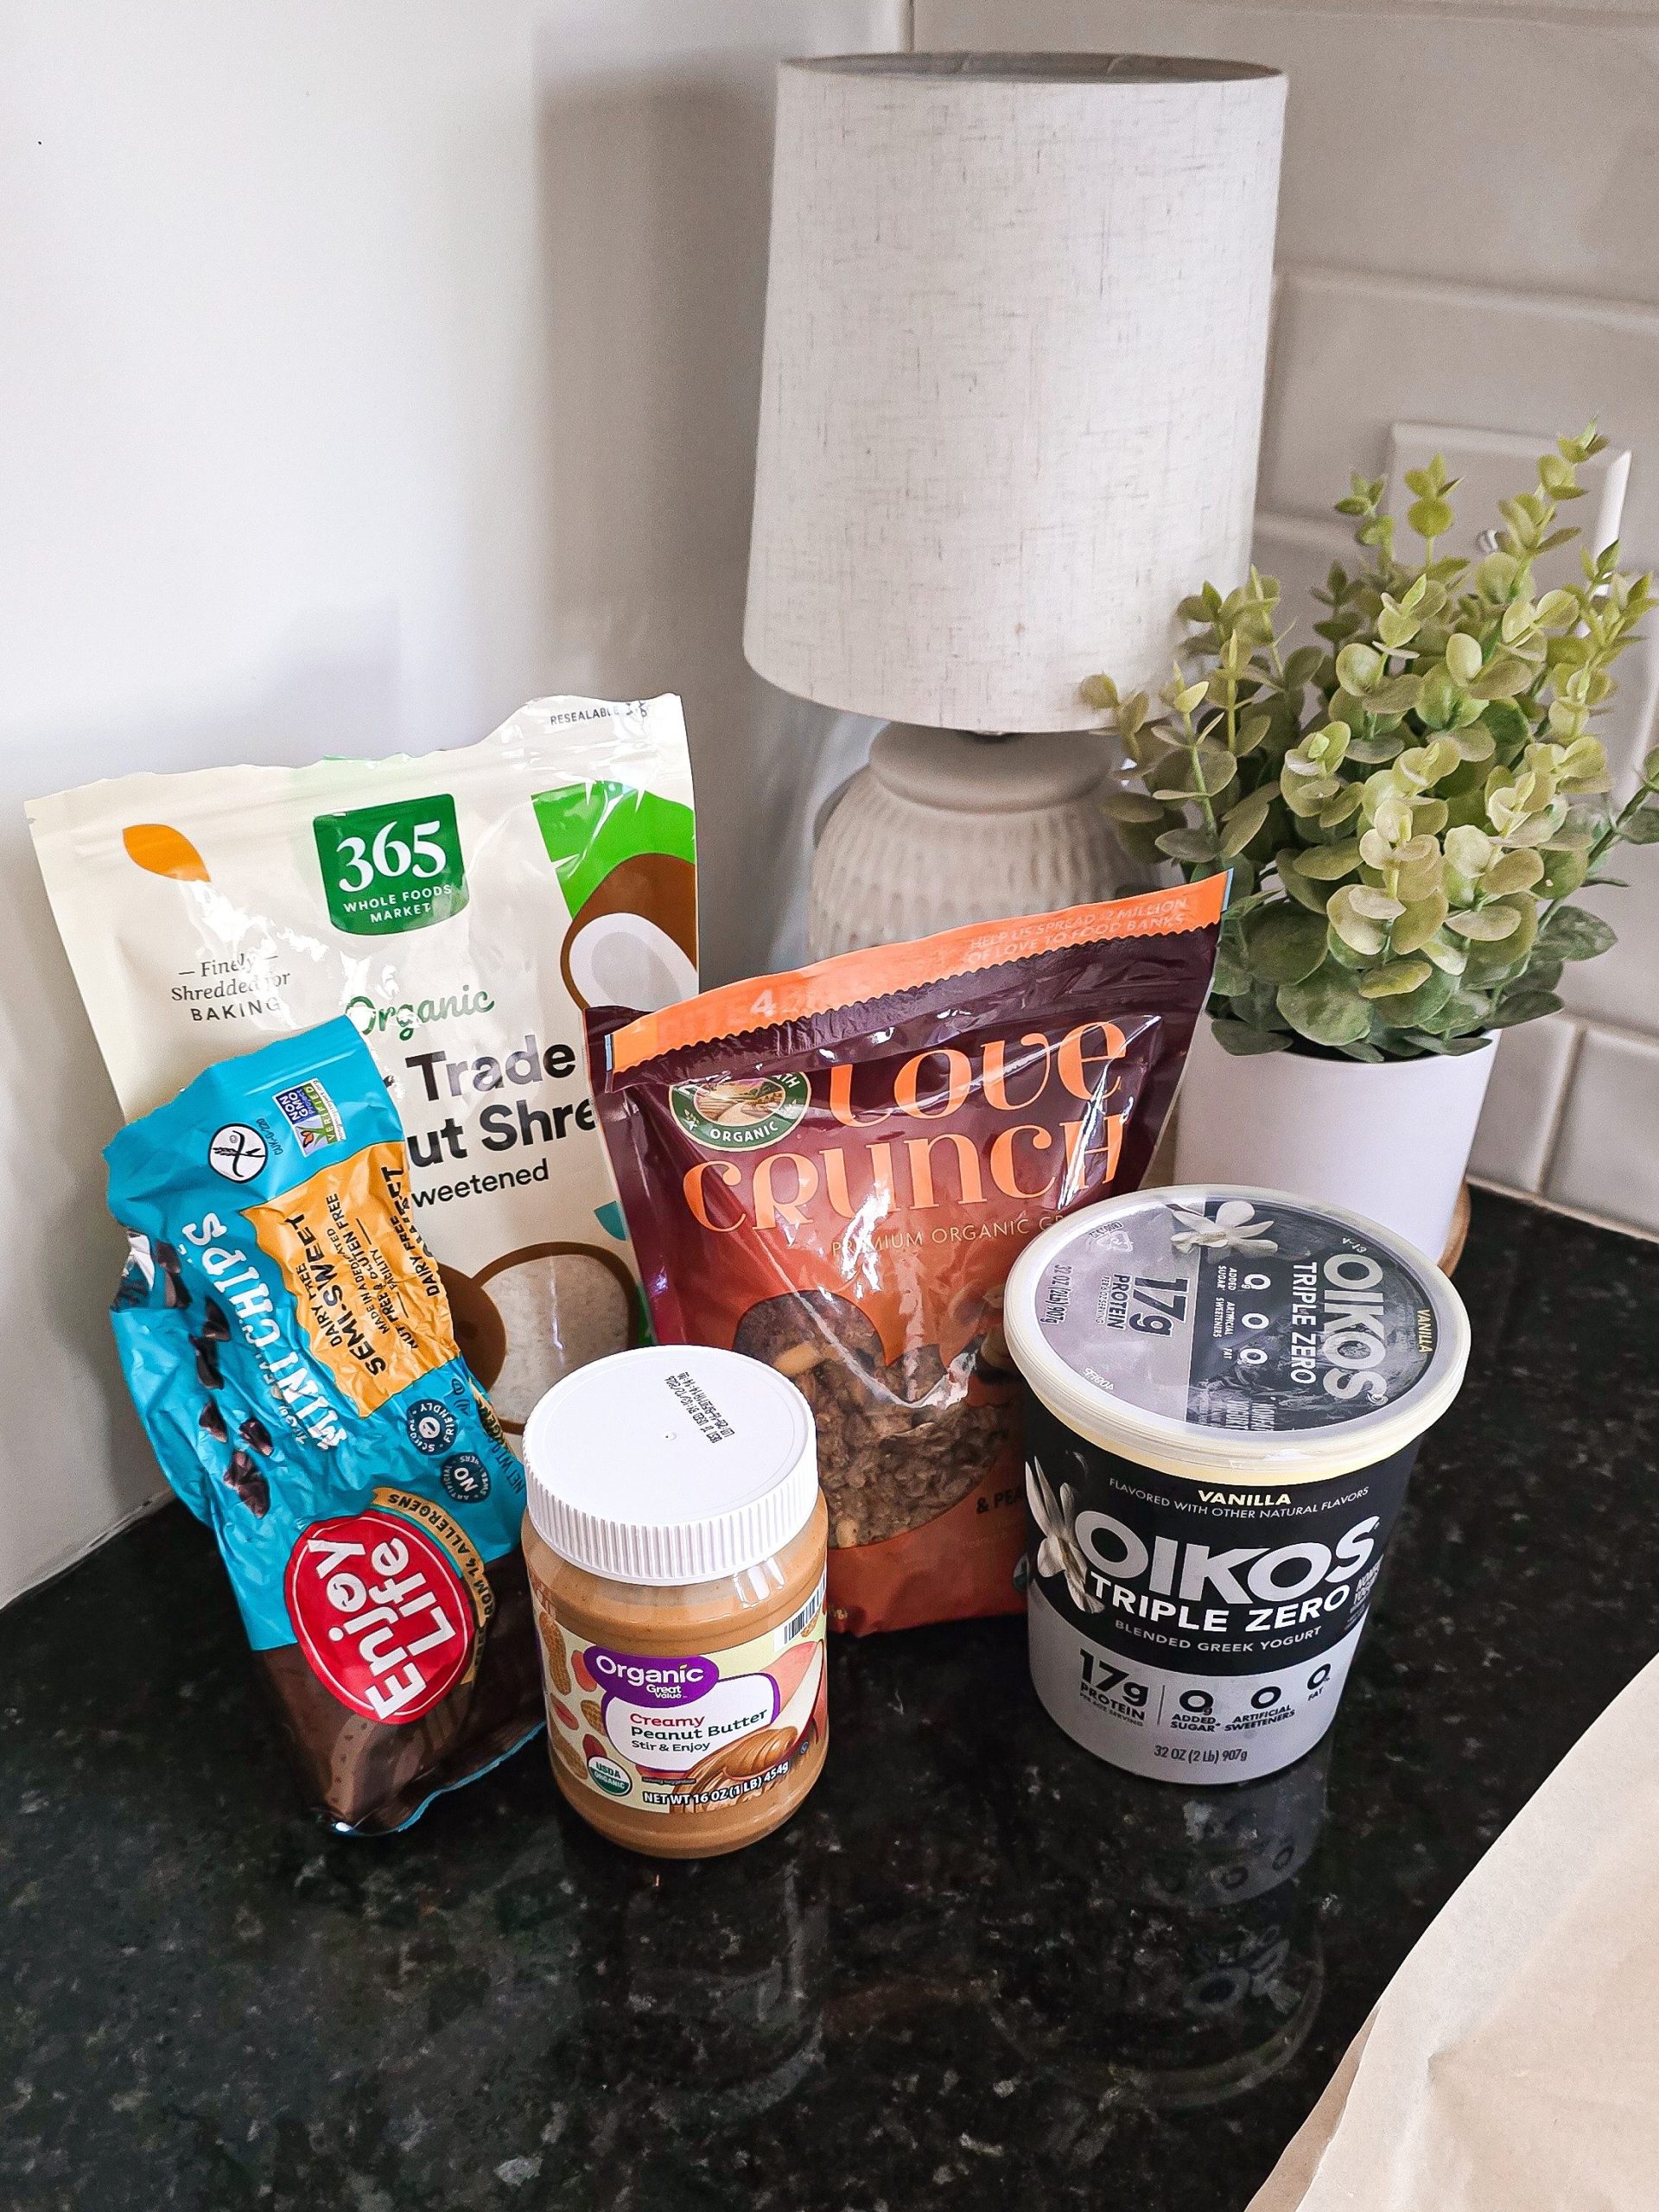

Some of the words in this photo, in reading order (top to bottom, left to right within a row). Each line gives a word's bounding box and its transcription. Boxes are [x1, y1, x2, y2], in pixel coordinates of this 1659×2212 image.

[336, 821, 447, 892] 365
[343, 894, 397, 912] WHOLE
[403, 885, 453, 901] FOODS
[370, 903, 432, 923] MARKET
[970, 931, 1009, 949] HELP
[1012, 926, 1034, 941] US
[1037, 913, 1096, 933] SPREAD
[1116, 899, 1188, 919] MILLION
[995, 939, 1039, 957] LOVE
[1127, 914, 1185, 931] BANKS
[190, 997, 282, 1021] BAKING
[346, 984, 495, 1040] Organic
[405, 1035, 576, 1102] Trade
[279, 1095, 301, 1122] NON
[289, 1091, 309, 1118] GMO
[305, 1085, 335, 1142] VERIFIED
[709, 1121, 779, 1142] ORGANIC
[325, 1193, 349, 1229] FREE
[390, 1214, 413, 1250] FREE
[831, 1232, 924, 1256] PRMIUM
[931, 1218, 1030, 1243] ORGANIC
[181, 1212, 281, 1348] CHIPS
[371, 1248, 397, 1289] FACILITY
[410, 1252, 440, 1296] DAIRY
[1052, 1275, 1070, 1285] OZ
[1054, 1264, 1071, 1274] 32
[1227, 1267, 1237, 1291] ADDED
[286, 1213, 387, 1375] SEMI-SWEET
[359, 1291, 372, 1304] IN
[377, 1291, 399, 1322] FREE
[1108, 1274, 1131, 1330] PROTEIN
[1128, 1275, 1190, 1338] 17g
[1292, 1262, 1318, 1326] TRIPLE
[311, 1304, 342, 1346] DAIRY
[365, 1304, 389, 1334] MADE
[1039, 1306, 1065, 1324] 907g
[1212, 1297, 1224, 1338] SWEETENERS
[1225, 1301, 1236, 1335] ARTIFICIAL
[1324, 1254, 1388, 1400] OIKOS
[1416, 1309, 1433, 1354] VANILLA
[397, 1323, 418, 1350] NUT
[1223, 1348, 1233, 1360] FAT
[1291, 1332, 1317, 1384] ZERO
[270, 1351, 347, 1450] MINI
[421, 1402, 455, 1443] FRIENDLY
[454, 1467, 479, 1492] NO
[1109, 1478, 1170, 1507] FLAVORED
[1174, 1501, 1207, 1515] WITH
[1211, 1508, 1255, 1519] OTHER
[1260, 1504, 1319, 1518] NATURAL
[1321, 1486, 1370, 1510] FLAVORS
[1198, 1490, 1292, 1506] VANILLA
[389, 1492, 470, 1554] ALLERGENS
[464, 1559, 481, 1576] 14
[1075, 1510, 1380, 1604] OIKOS
[368, 1537, 456, 1656] Life
[1090, 1571, 1229, 1632] TRIPLE
[1245, 1585, 1350, 1632] ZERO
[307, 1538, 428, 1719] Enjoy
[1115, 1619, 1192, 1649] BLENDED
[1197, 1641, 1255, 1653] GREEK
[1260, 1625, 1322, 1649] YOGURT
[596, 1655, 704, 1687] Organic
[1080, 1647, 1149, 1707] 17g
[646, 1684, 682, 1694] Great
[1080, 1681, 1145, 1720] PROTEIN
[1307, 1687, 1324, 1701] FAT
[630, 1713, 705, 1728] Creamy
[631, 1726, 702, 1740] Peanut
[709, 1709, 768, 1738] Butter
[1172, 1713, 1217, 1725] ADDED
[1224, 1709, 1296, 1732] SWEETENERS
[1231, 1704, 1292, 1724] ARTIFICIAL
[632, 1740, 657, 1751] Stir
[673, 1742, 710, 1753] Enjoy
[1154, 1745, 1167, 1758] 32
[1171, 1749, 1187, 1760] OZ
[1222, 1749, 1248, 1762] 907g
[594, 1771, 626, 1789] ORGANIC
[596, 1762, 621, 1779] USDA
[644, 1791, 668, 1804] NET
[670, 1794, 690, 1804] WT
[693, 1792, 709, 1804] 16
[712, 1789, 728, 1802] OZ
[729, 1786, 742, 1800] (1
[744, 1779, 762, 1794] LB)
[764, 1762, 790, 1783] 454g
